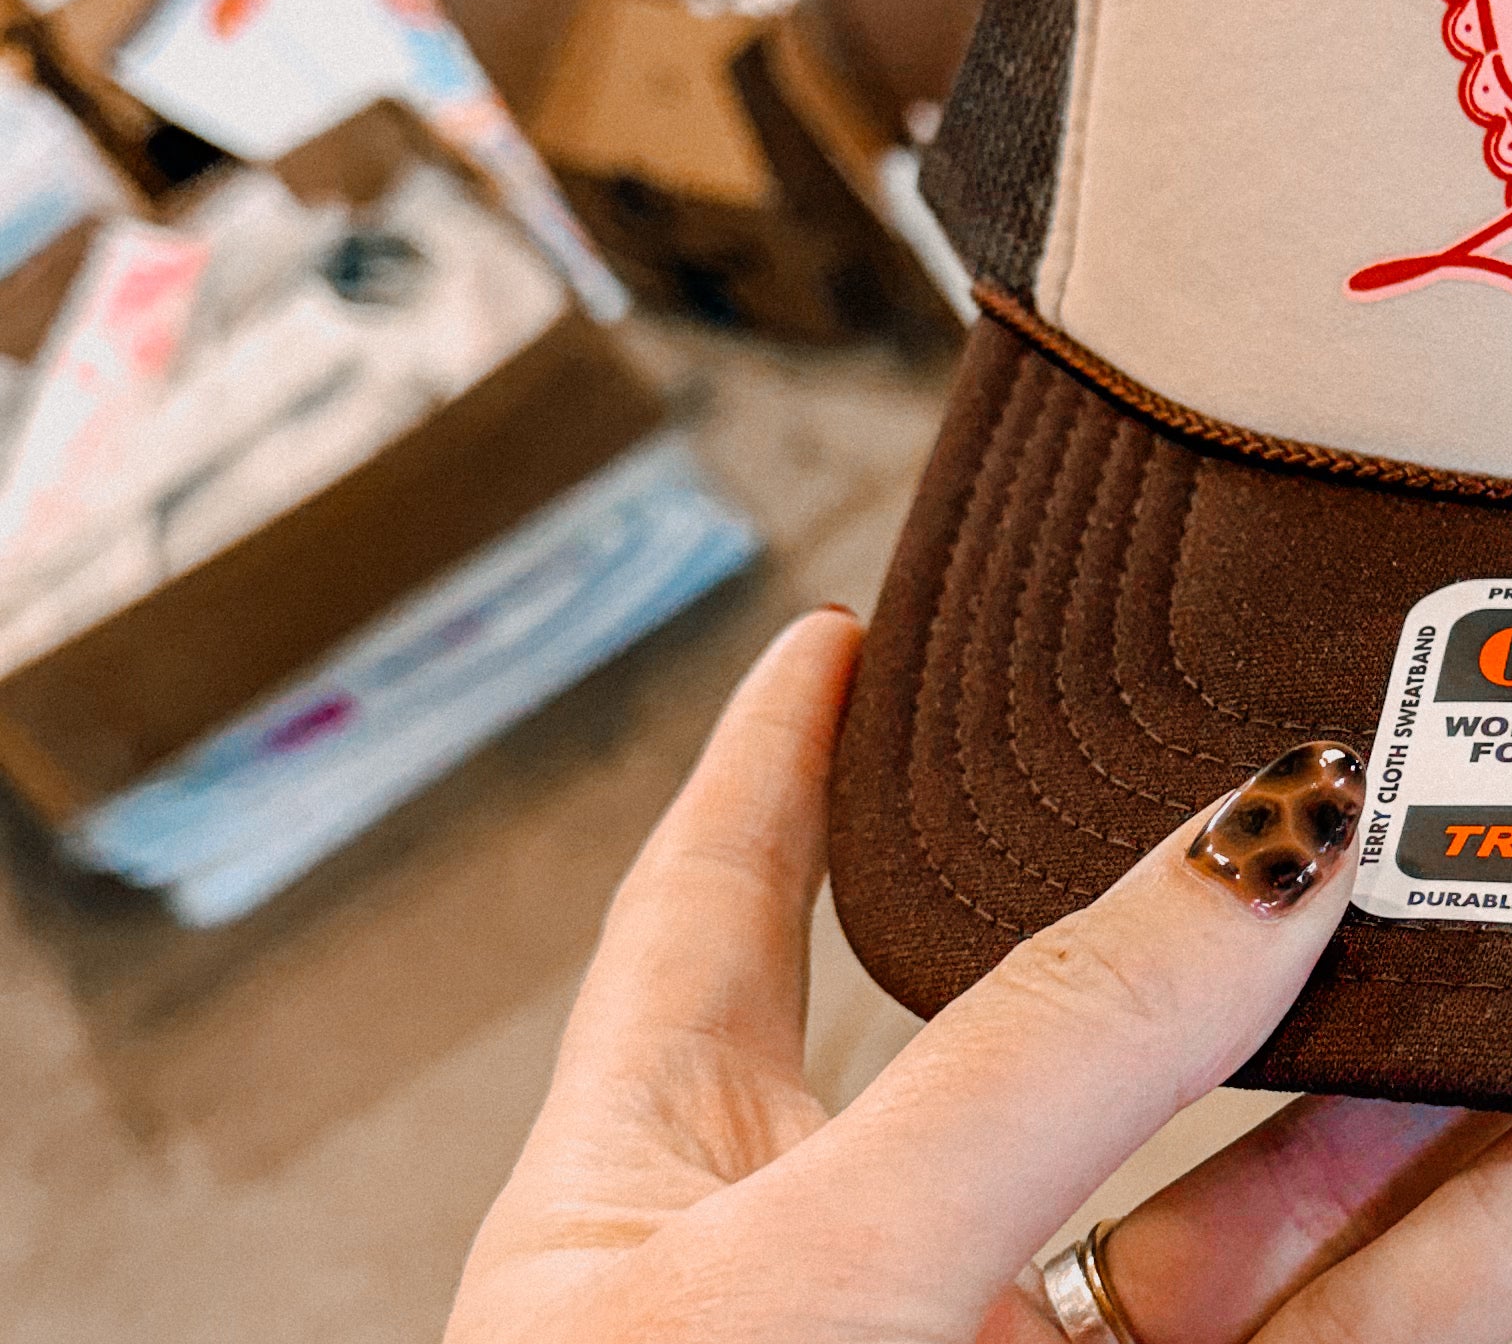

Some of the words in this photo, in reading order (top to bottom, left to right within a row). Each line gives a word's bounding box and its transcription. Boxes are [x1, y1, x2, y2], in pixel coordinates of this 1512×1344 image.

[1359, 809, 1392, 867] TERRY
[1376, 743, 1410, 804] CLOTH
[1394, 624, 1437, 739] SWEATBAND
